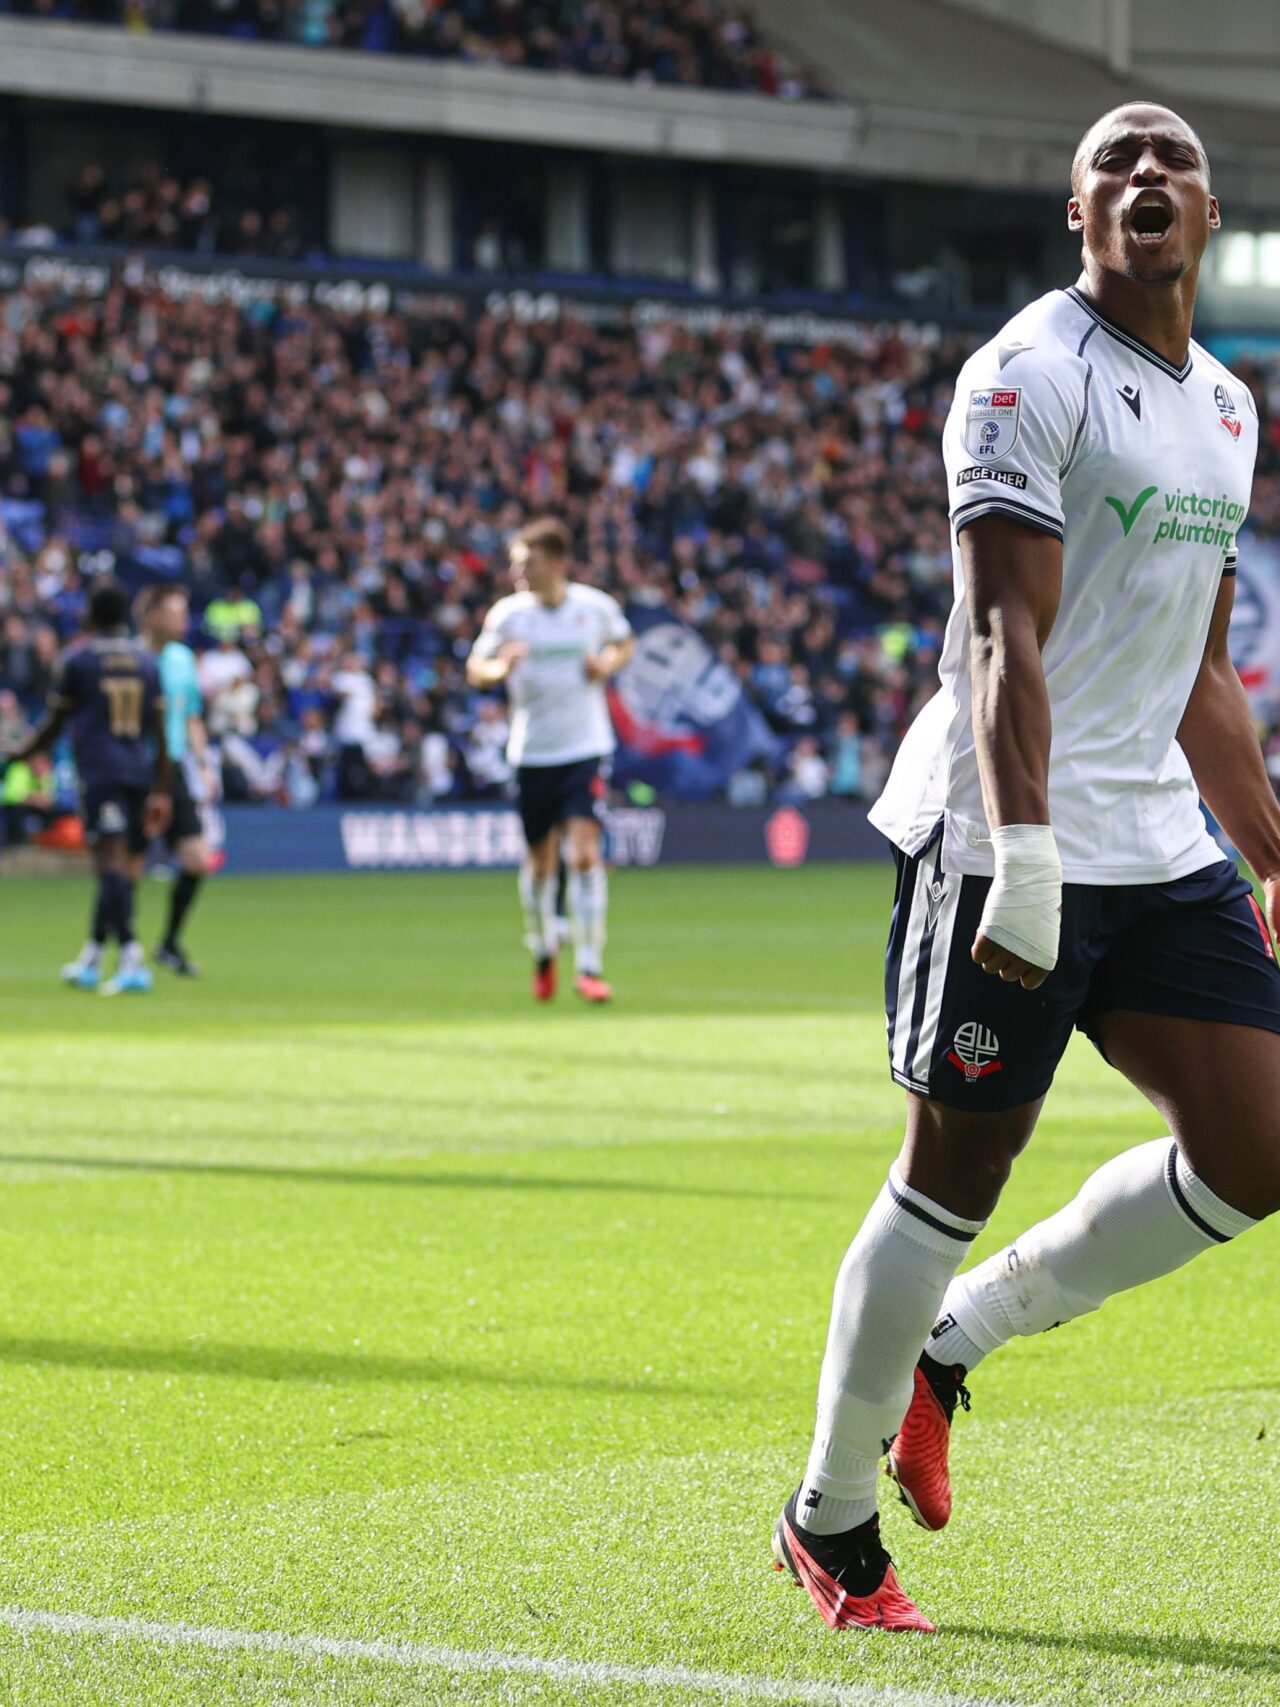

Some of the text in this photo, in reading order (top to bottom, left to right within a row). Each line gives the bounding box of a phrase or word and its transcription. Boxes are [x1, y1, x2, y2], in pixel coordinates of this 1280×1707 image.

[971, 393, 1014, 406] sky bet
[998, 408, 1014, 417] ONE
[979, 445, 995, 454] EFL
[957, 467, 1024, 488] TOGETHER
[1165, 488, 1245, 523] victorian
